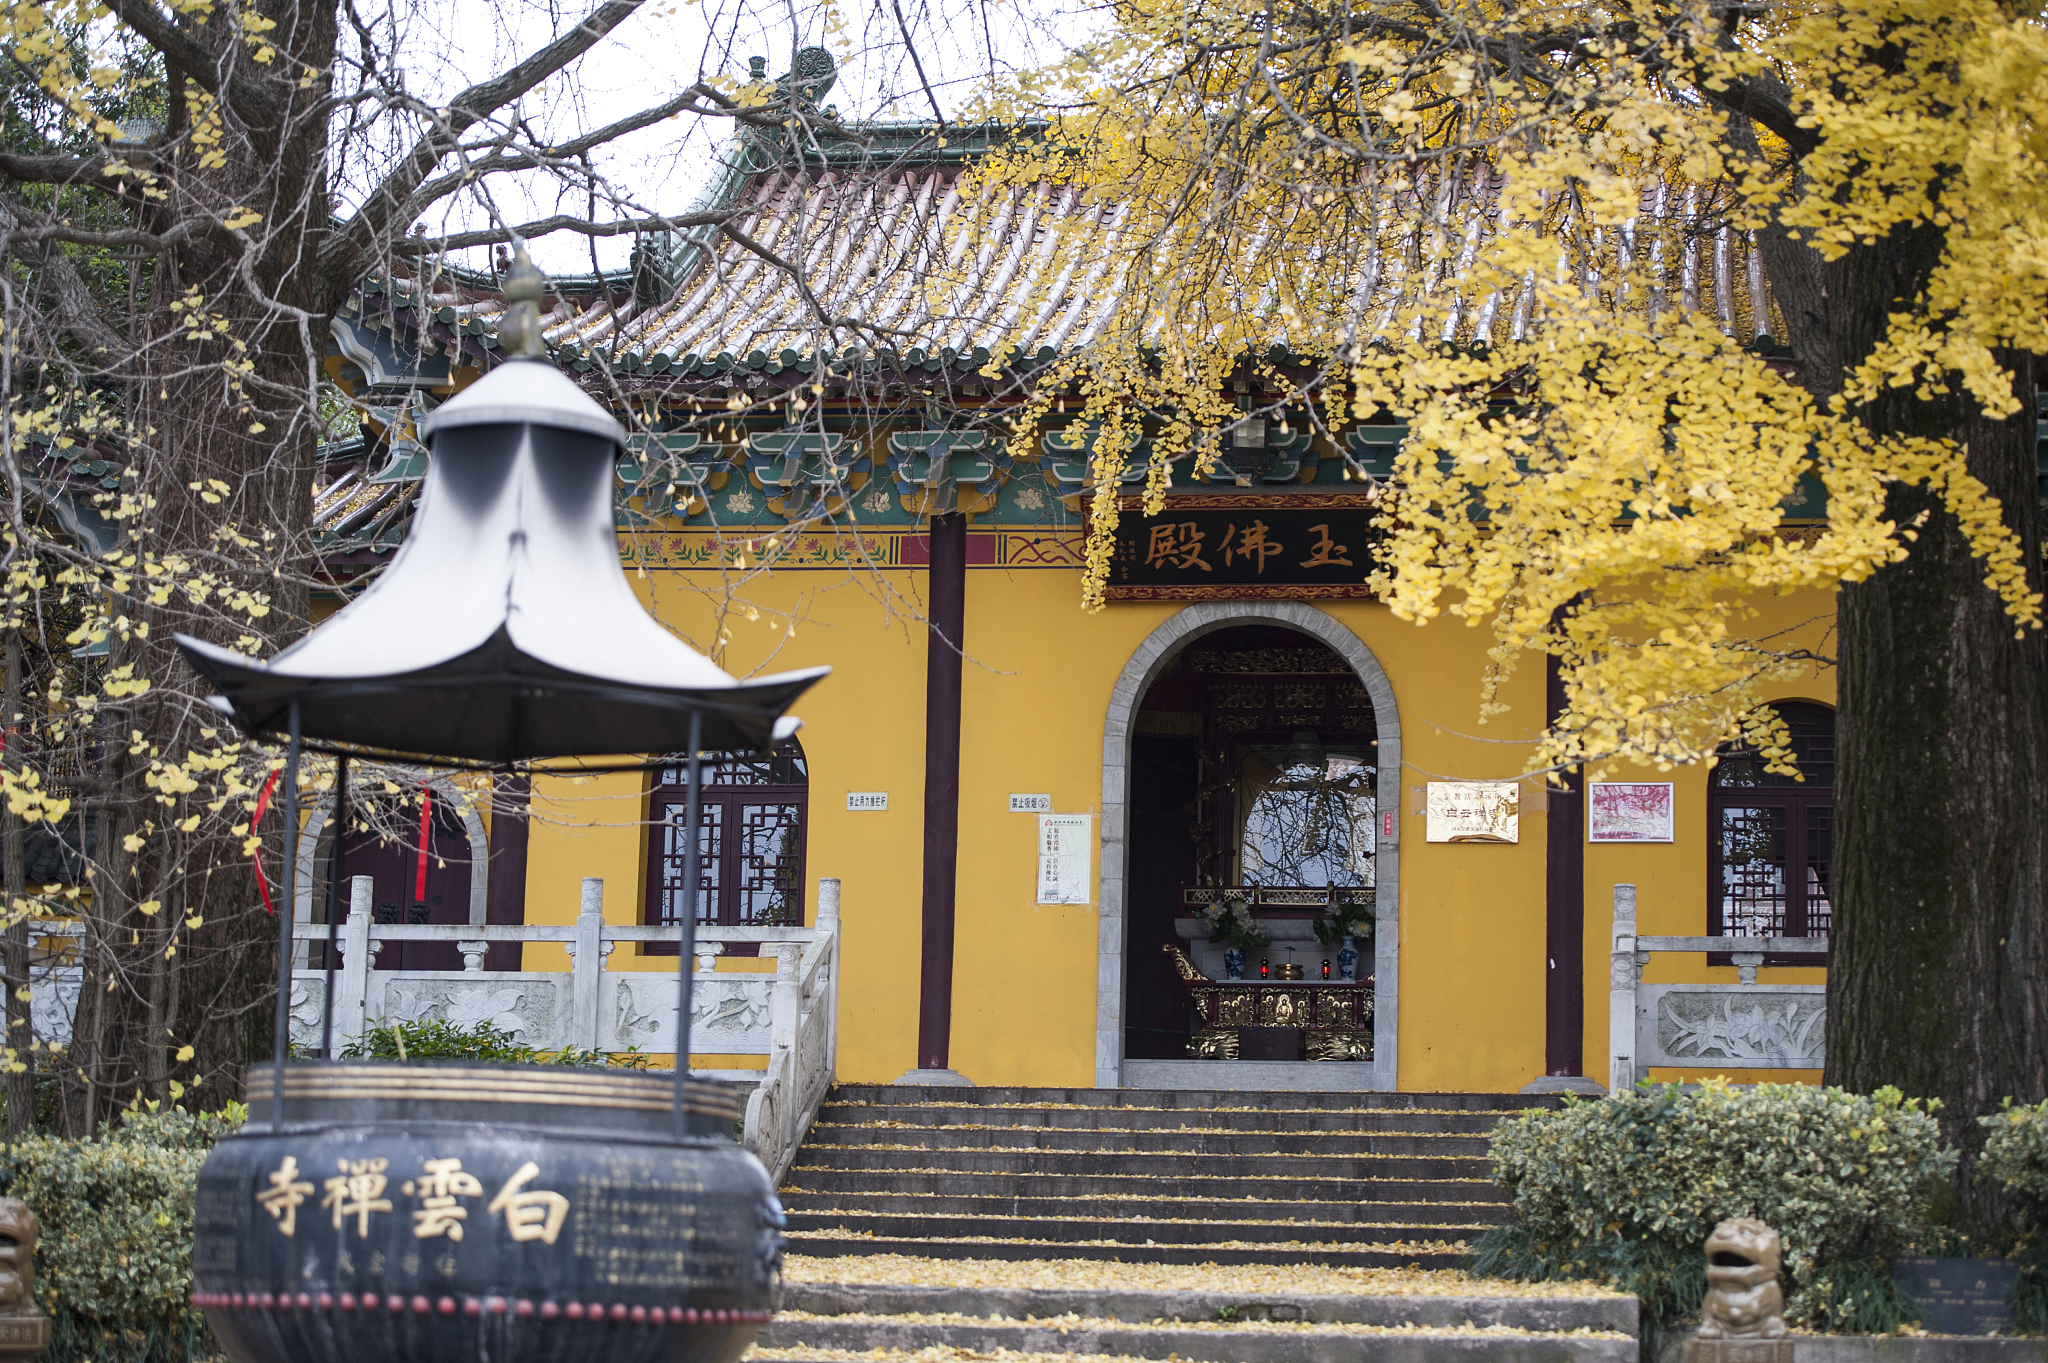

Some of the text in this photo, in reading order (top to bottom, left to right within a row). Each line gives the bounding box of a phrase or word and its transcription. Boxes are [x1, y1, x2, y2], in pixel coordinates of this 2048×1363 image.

[1144, 519, 1353, 575] 玉佛殿
[1012, 797, 1037, 809] 禁止吸烟
[256, 1154, 570, 1246] 白雲禪寺
